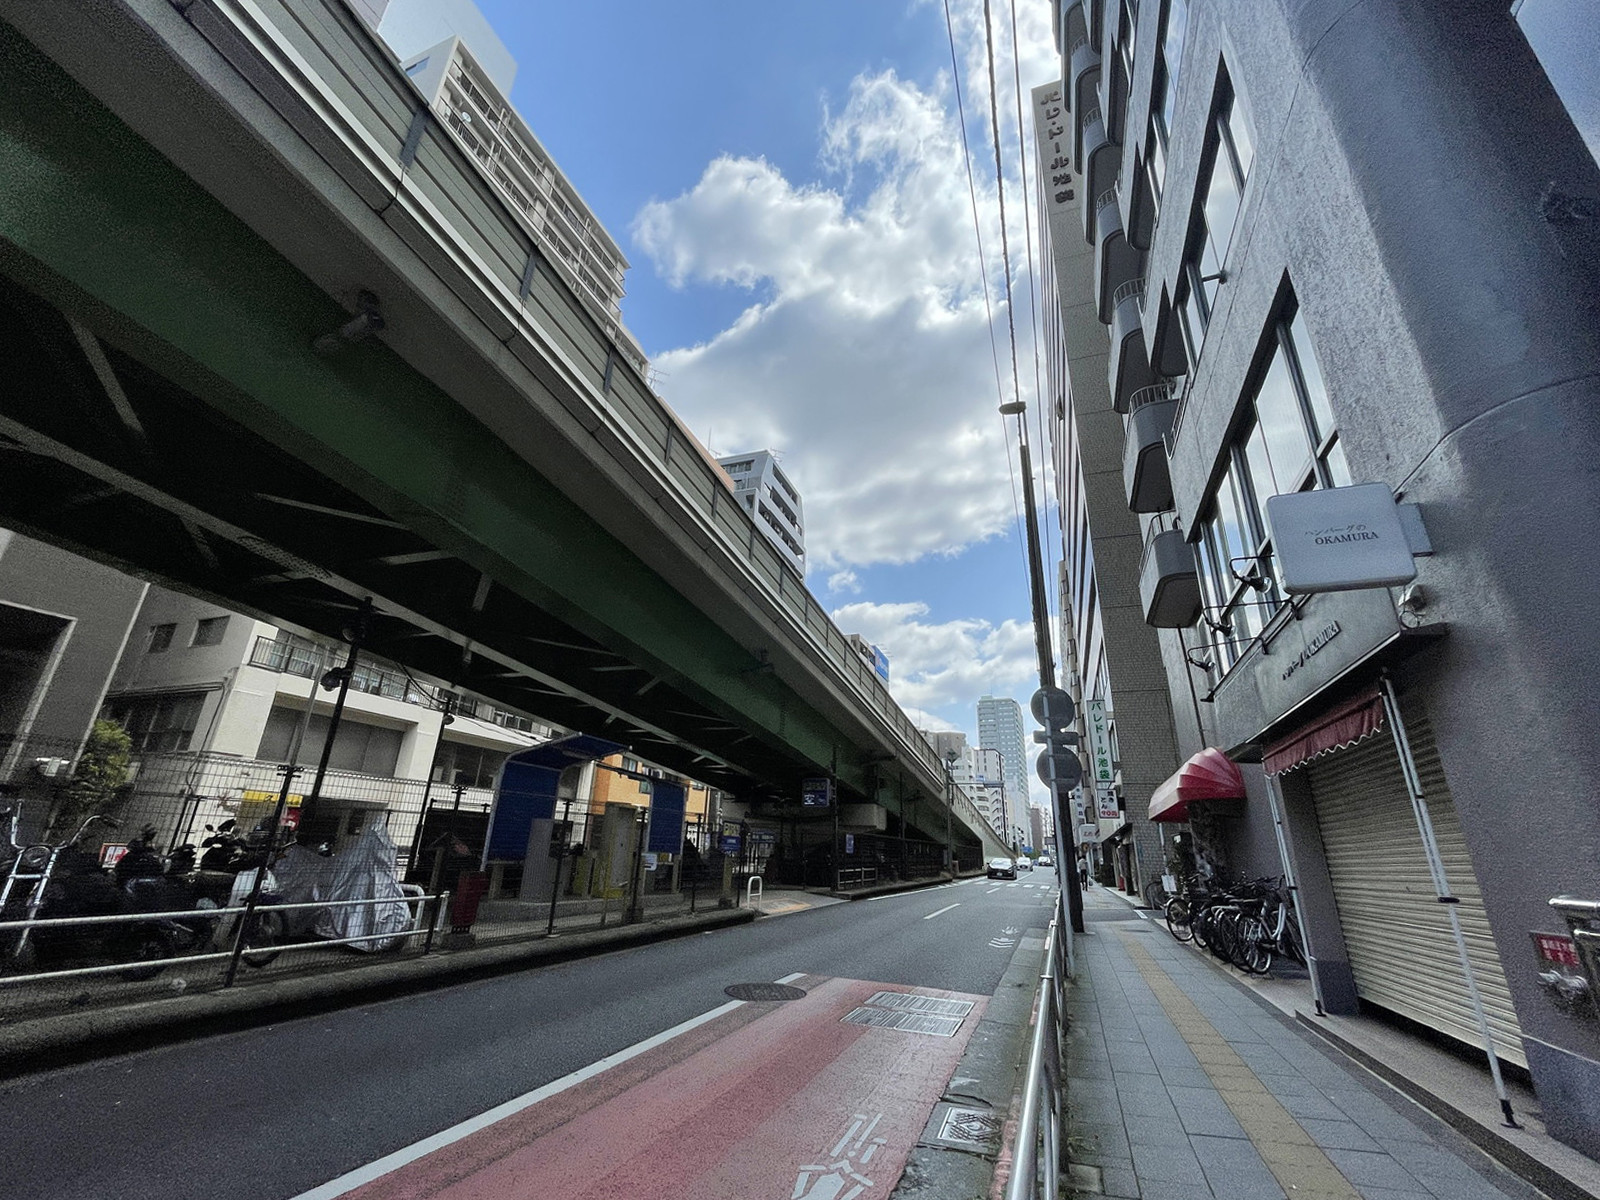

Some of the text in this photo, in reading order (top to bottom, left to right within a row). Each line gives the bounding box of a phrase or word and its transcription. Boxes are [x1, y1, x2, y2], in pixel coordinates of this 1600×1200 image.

[1304, 523, 1367, 536] ハンバーグの
[1314, 531, 1380, 545] OKAMURA
